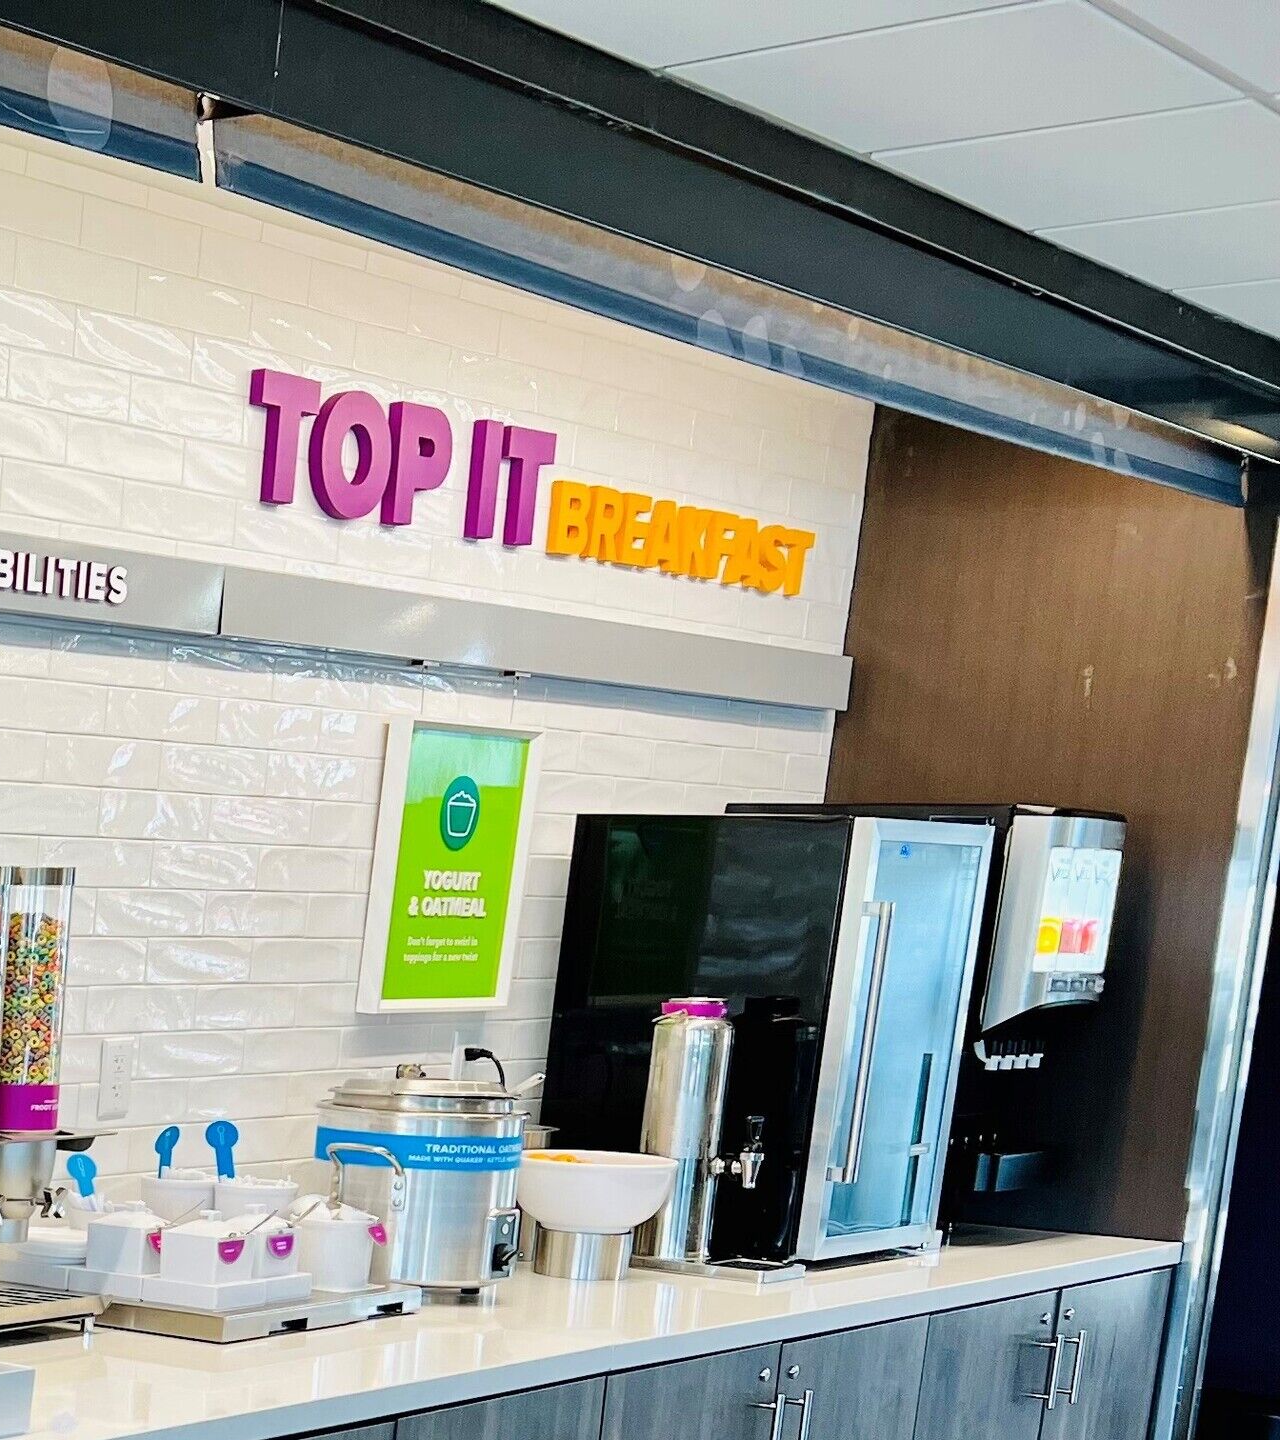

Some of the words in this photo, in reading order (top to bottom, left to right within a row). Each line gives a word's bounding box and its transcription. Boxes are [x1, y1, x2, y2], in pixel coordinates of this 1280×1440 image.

[250, 368, 453, 525] TOP
[463, 419, 557, 547] IT
[546, 480, 815, 596] BREAKFAST
[424, 870, 481, 891] YOGURT
[408, 896, 419, 916] &
[422, 896, 486, 918] OATMEAL
[425, 1143, 496, 1154] TRADITIONAL
[433, 1155, 453, 1163] WITH
